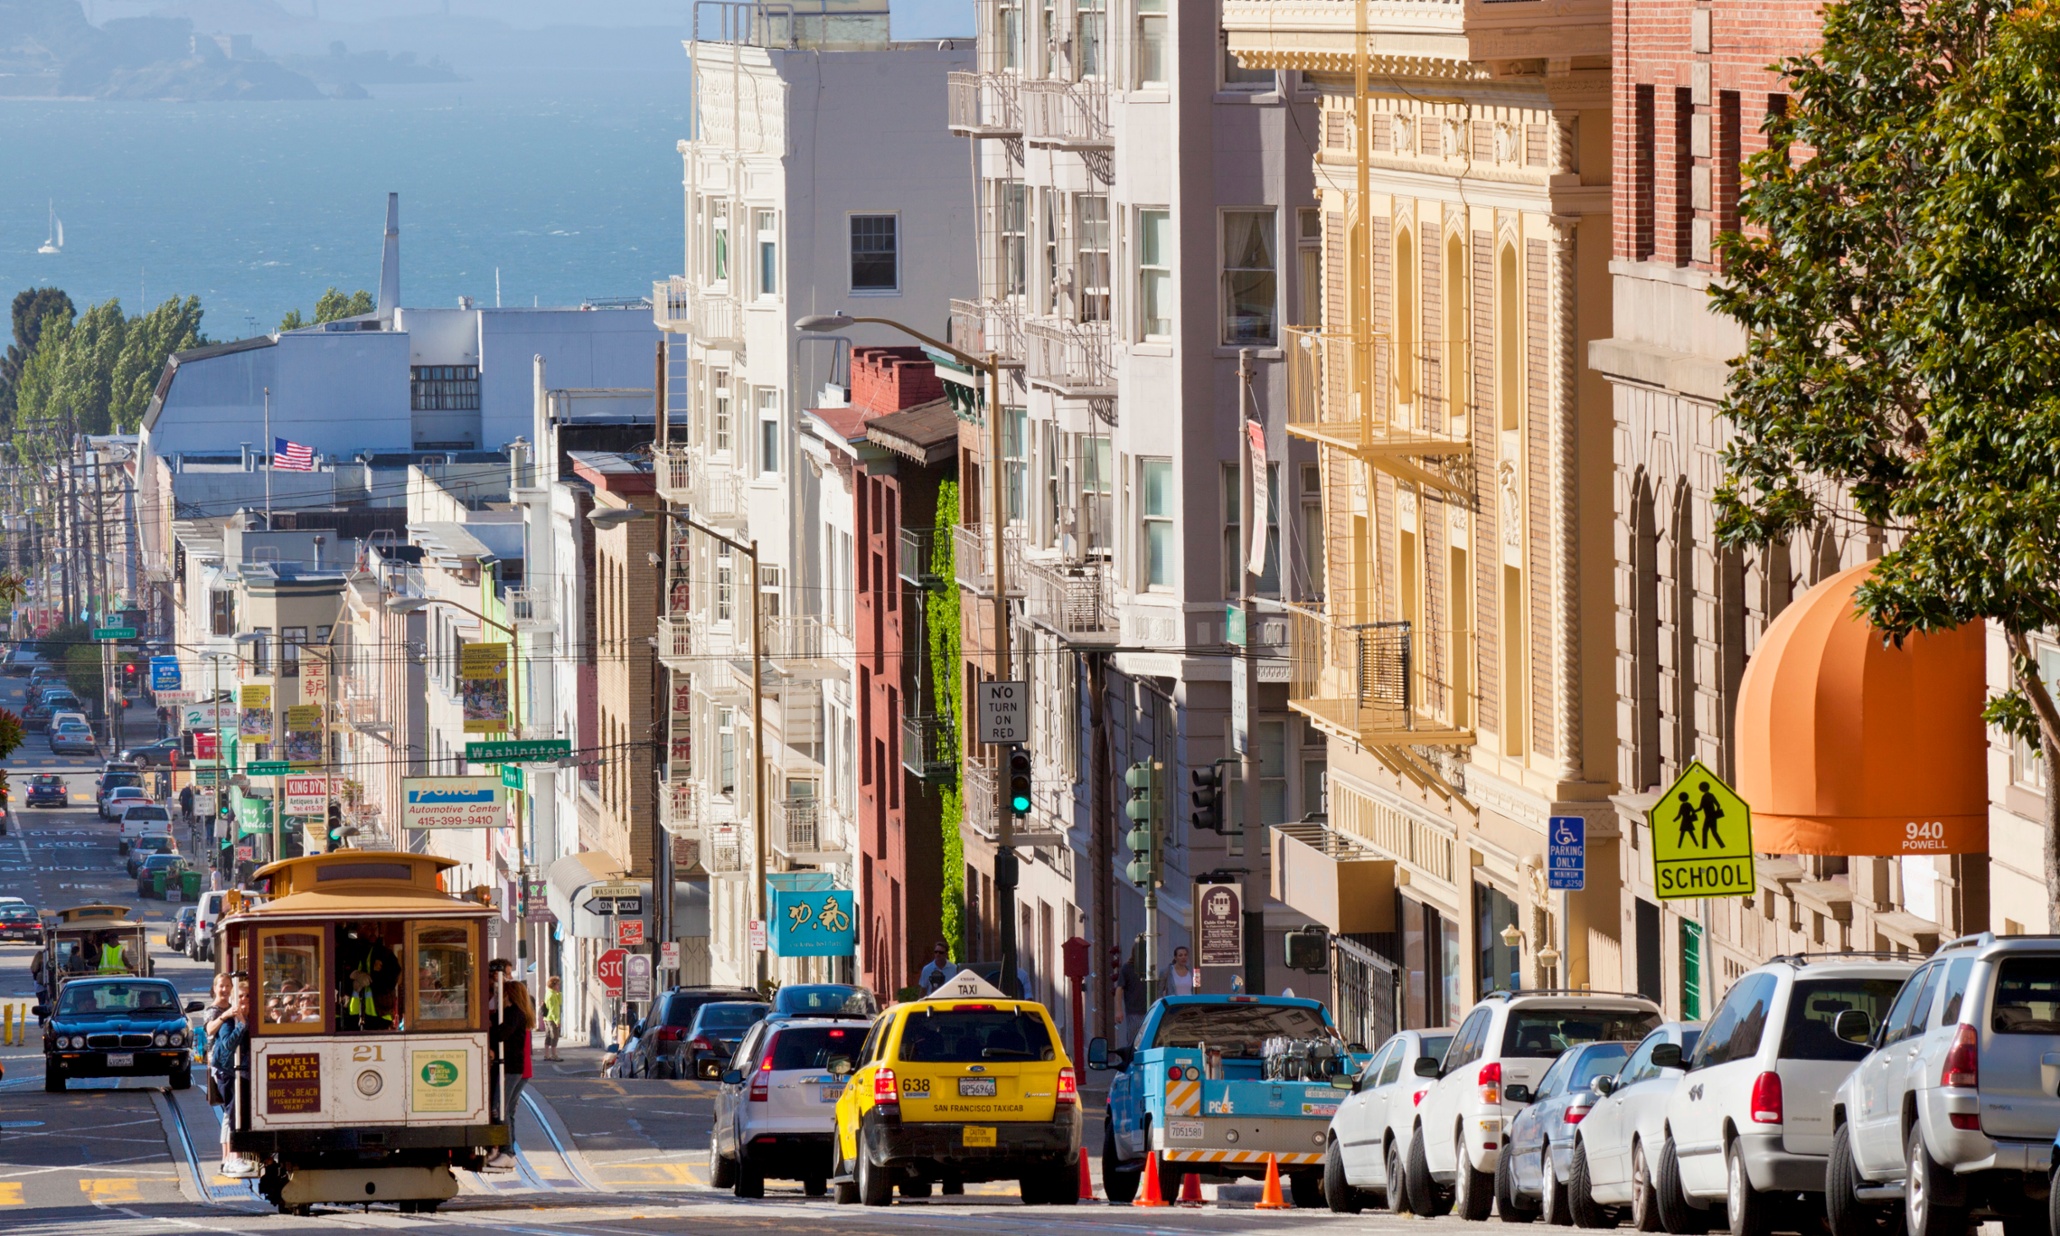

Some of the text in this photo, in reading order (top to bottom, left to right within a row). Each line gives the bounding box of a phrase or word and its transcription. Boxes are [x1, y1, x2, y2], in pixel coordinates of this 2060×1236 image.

[991, 687, 1014, 698] NO
[989, 702, 1017, 712] TURN
[995, 715, 1011, 725] ON
[992, 728, 1014, 738] RED
[471, 746, 566, 760] Washington
[504, 770, 522, 784] Powel
[289, 780, 341, 794] KING DYNST
[416, 780, 478, 802] Powell
[290, 798, 313, 806] Antiques
[408, 805, 502, 814] Automotive Center
[418, 816, 493, 826] 415-399-9410
[1906, 822, 1944, 840] 940
[1902, 840, 1948, 849] POWELL
[1550, 846, 1583, 856] PARKING
[1556, 857, 1576, 867] ONLY
[1662, 864, 1748, 889] SCHOOL
[600, 962, 622, 976] STO
[958, 985, 977, 994] TAXI
[353, 1045, 385, 1062] 21
[269, 1057, 317, 1066] POWELL
[269, 1071, 318, 1079] MARKET
[903, 1078, 930, 1092] 638
[269, 1089, 285, 1097] HYDE
[296, 1088, 318, 1096] BEACH
[1209, 1101, 1233, 1114] PG&E
